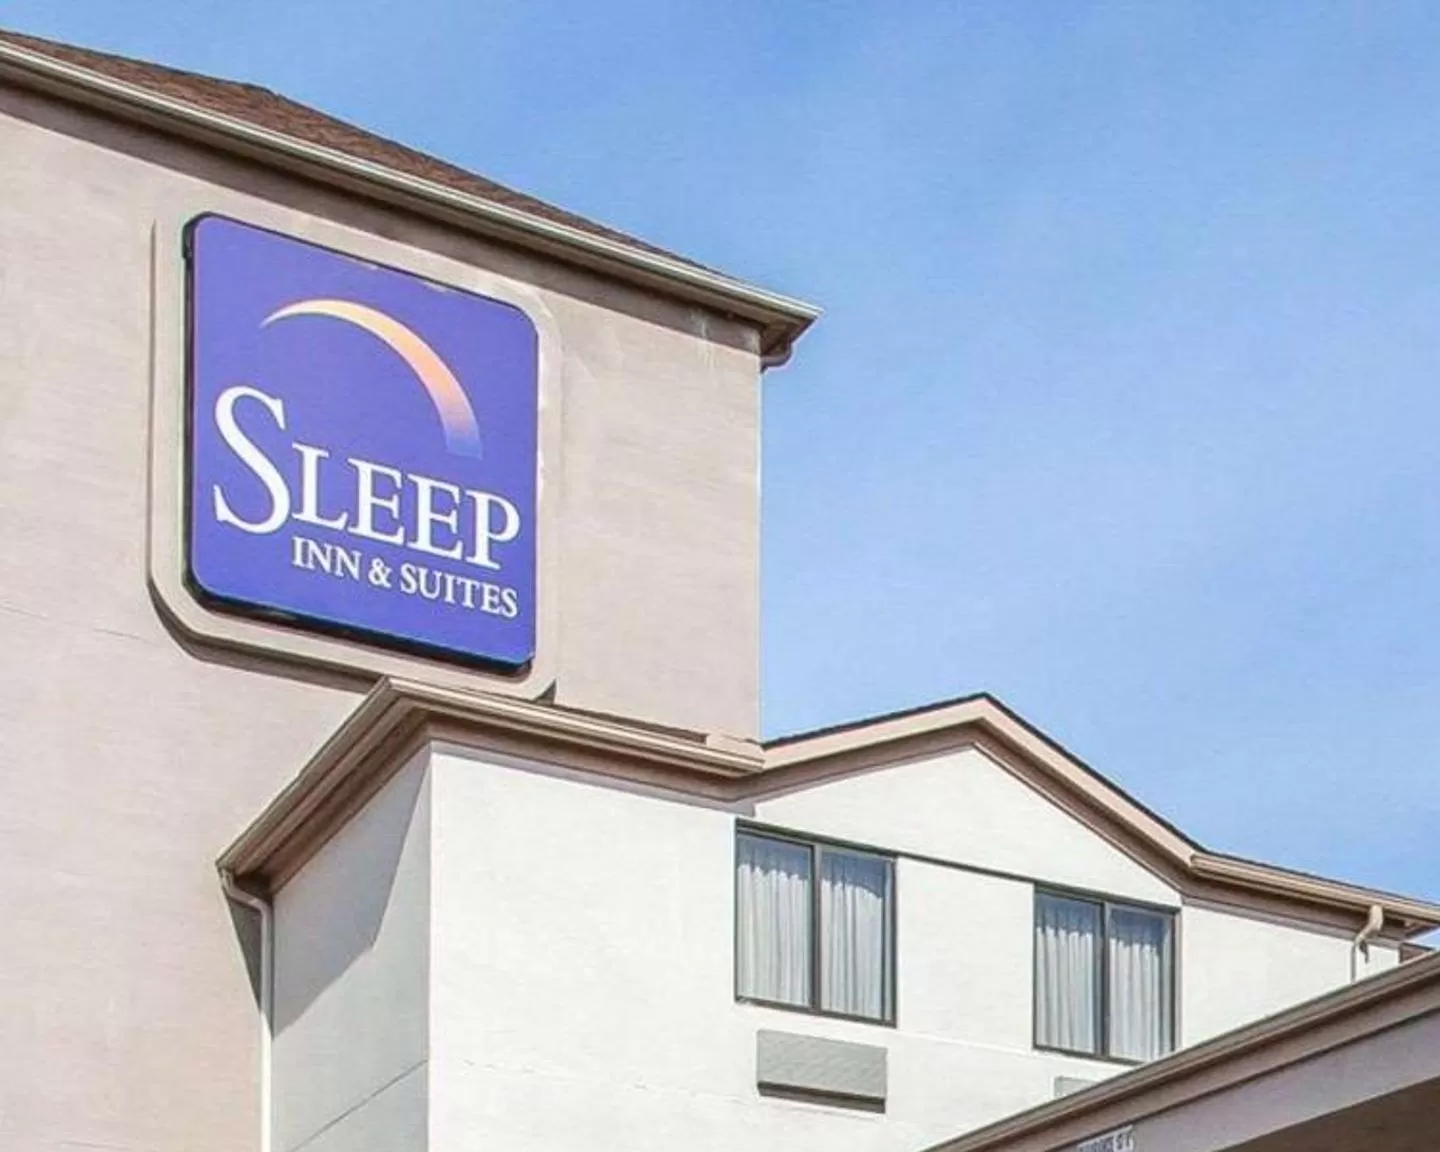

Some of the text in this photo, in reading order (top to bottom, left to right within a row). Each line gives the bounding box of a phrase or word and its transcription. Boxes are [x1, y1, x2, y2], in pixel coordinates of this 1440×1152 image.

[215, 386, 520, 568] SLEEP
[292, 536, 518, 618] INN & SUITES
